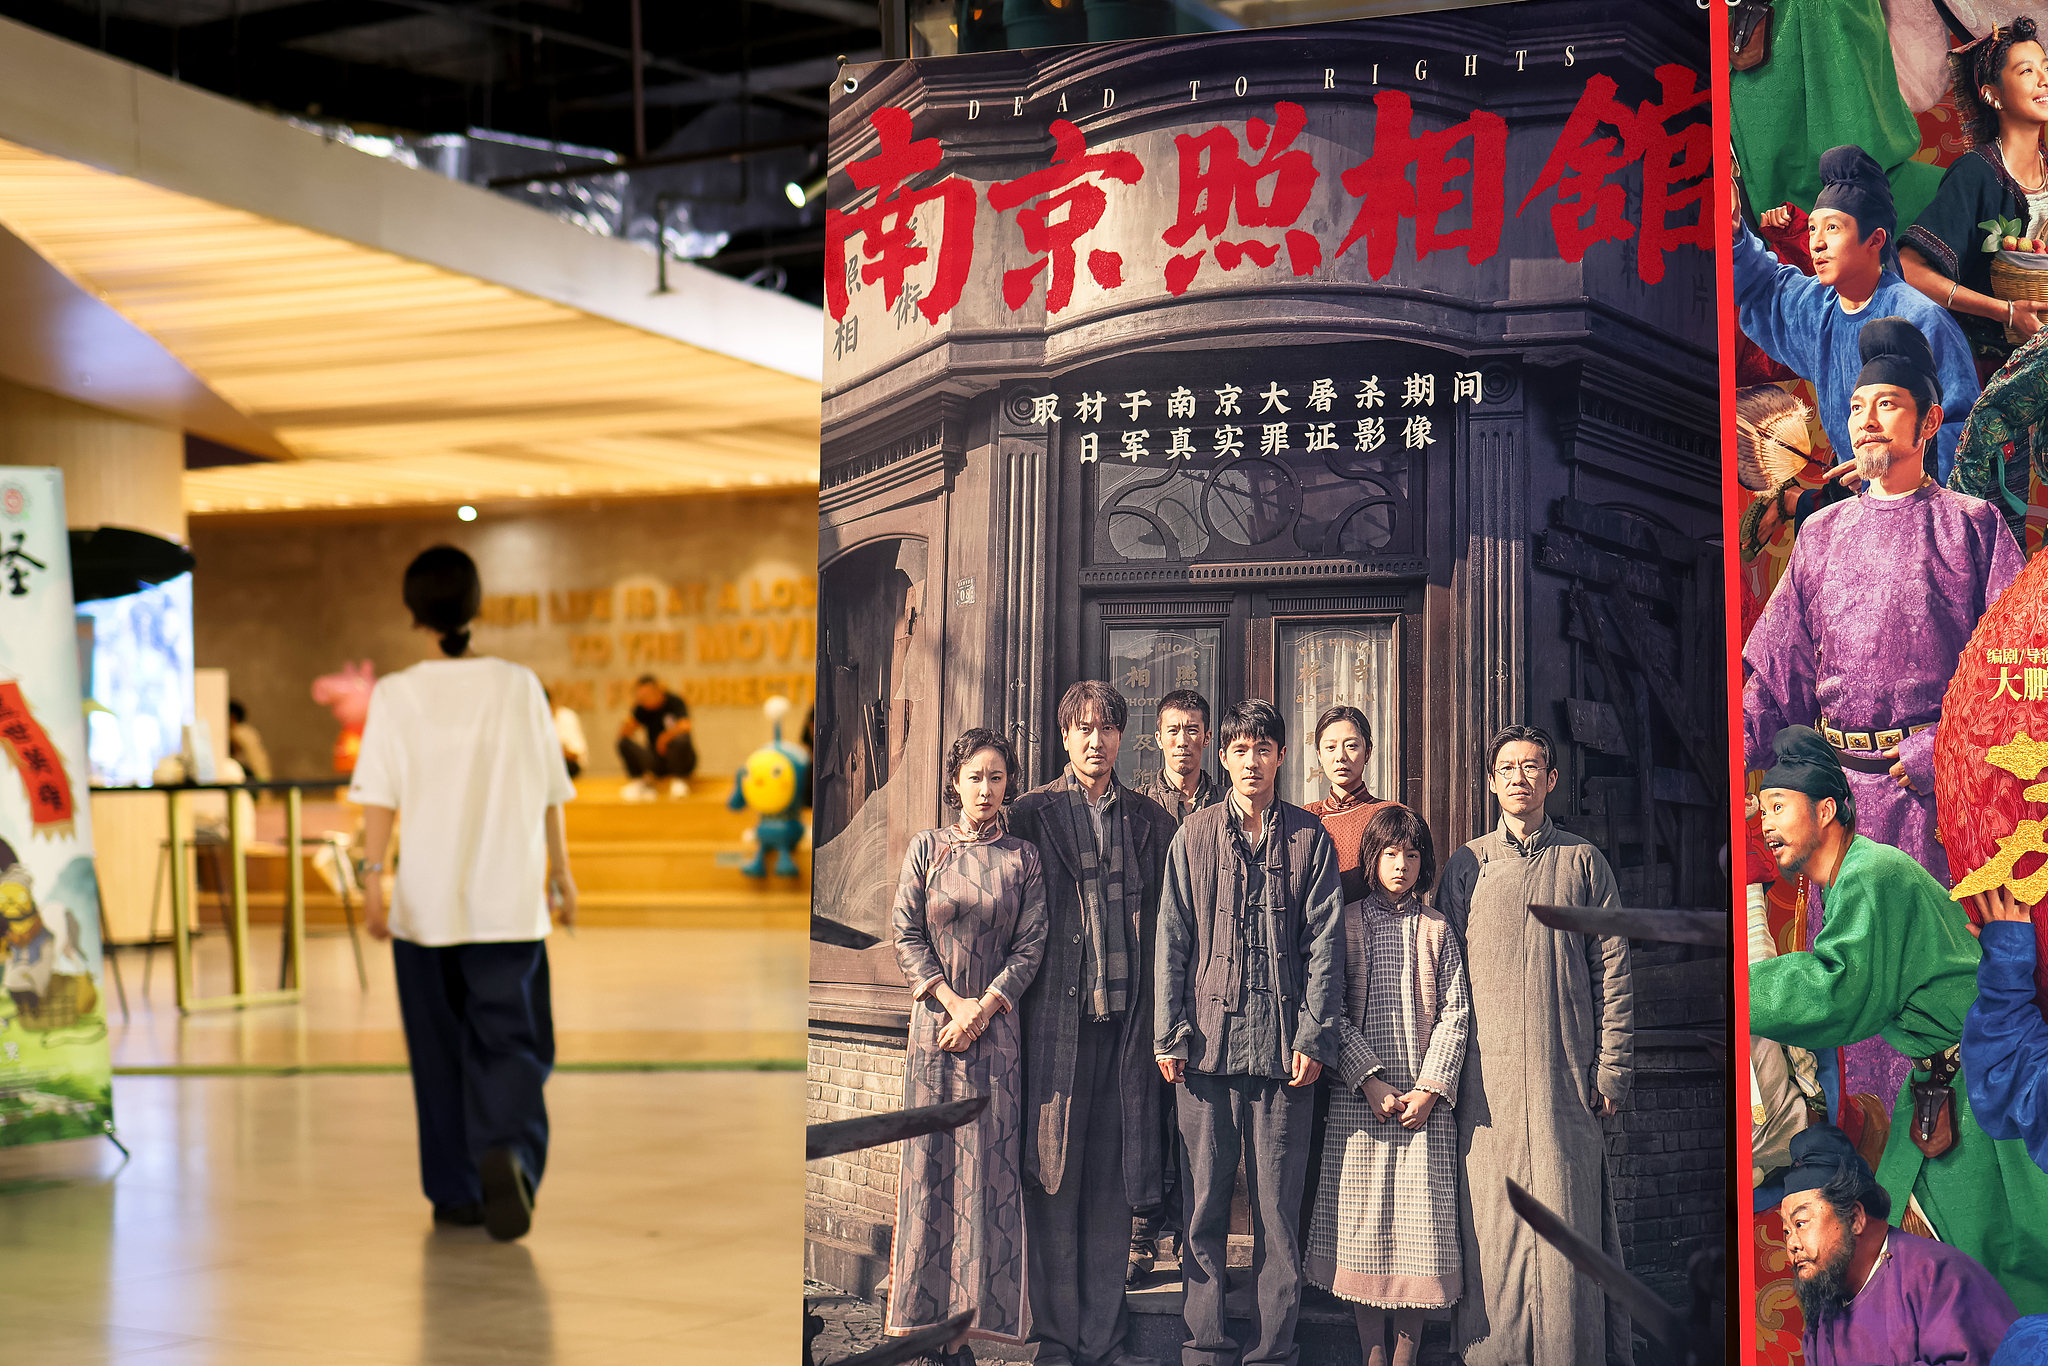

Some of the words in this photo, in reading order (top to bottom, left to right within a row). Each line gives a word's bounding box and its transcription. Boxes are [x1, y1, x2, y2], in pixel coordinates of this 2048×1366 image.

[967, 87, 1116, 121] DEAD
[1188, 75, 1249, 102] TO
[1322, 44, 1577, 91] RIGHTS
[825, 63, 1714, 326] 南京照相館
[1029, 370, 1486, 428] 取材于南京大屠杀期间
[1079, 413, 1438, 465] 日军真实罪证影像
